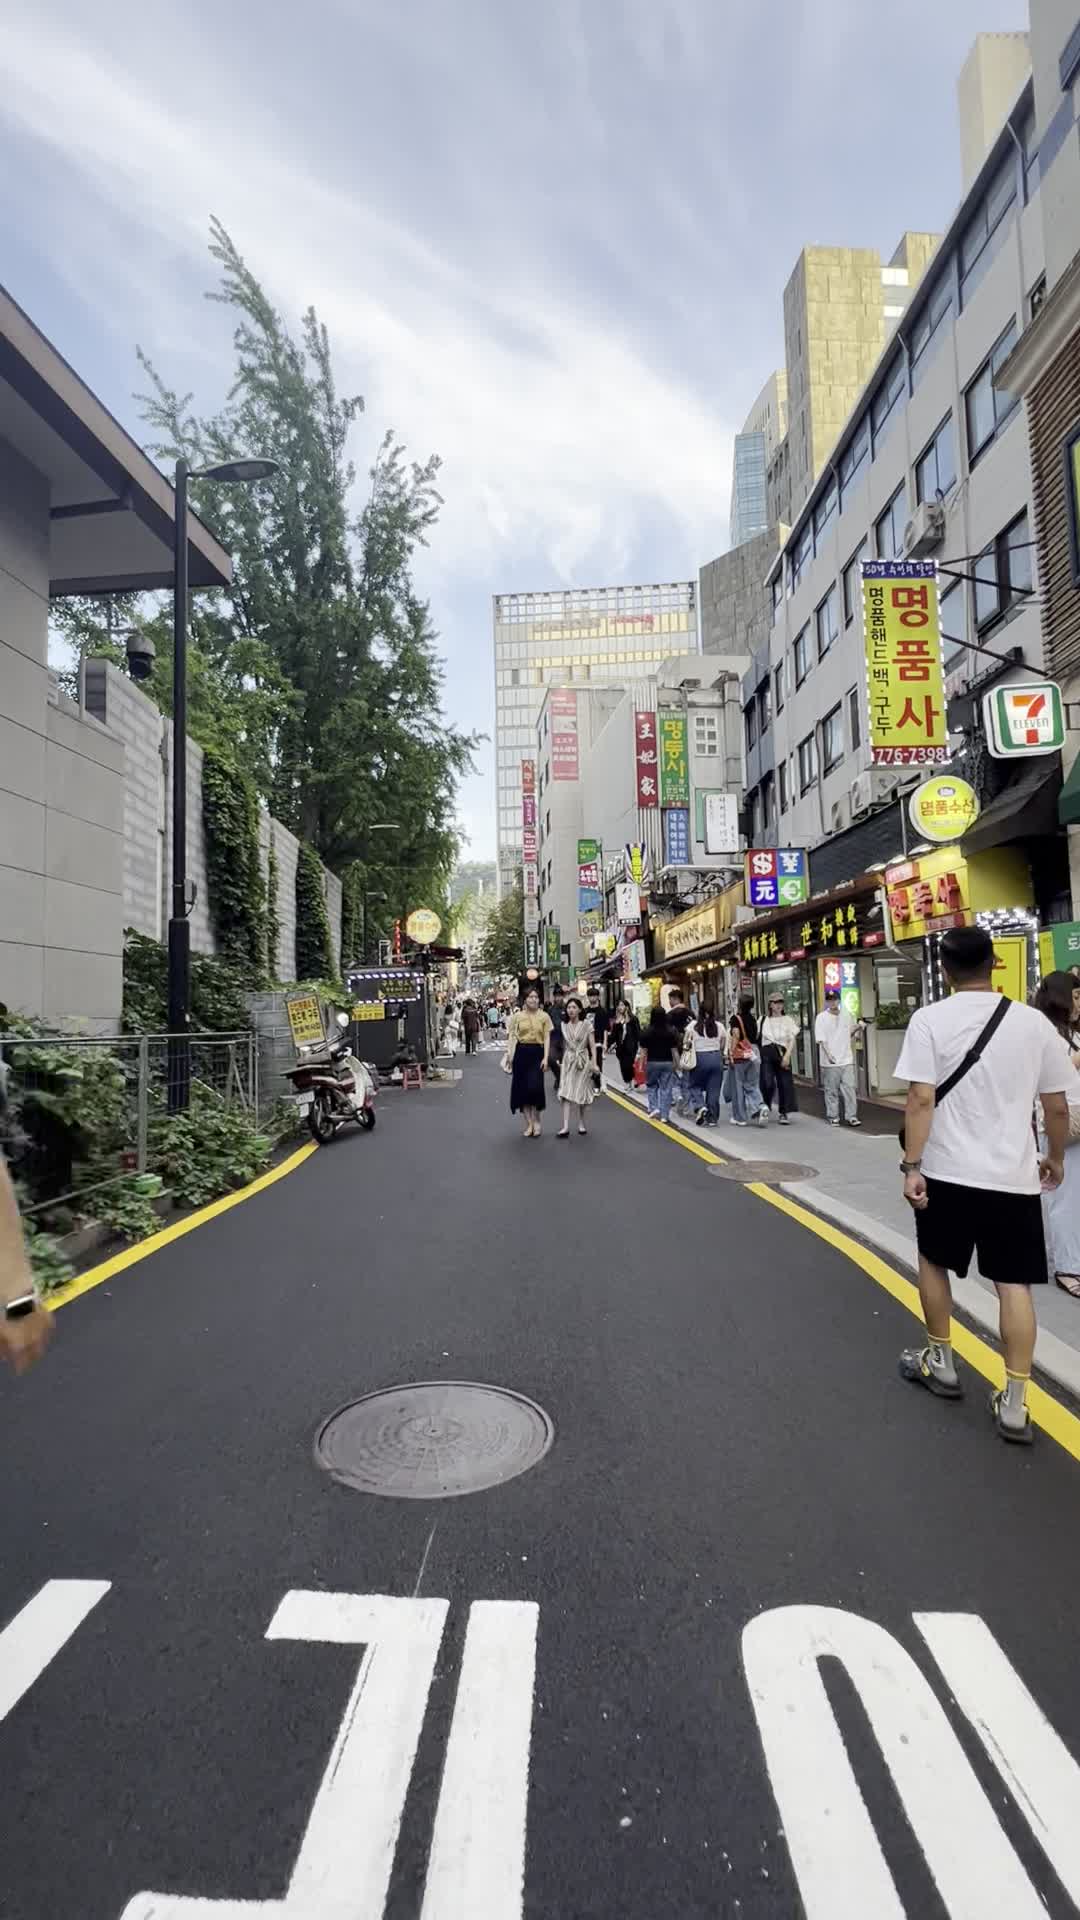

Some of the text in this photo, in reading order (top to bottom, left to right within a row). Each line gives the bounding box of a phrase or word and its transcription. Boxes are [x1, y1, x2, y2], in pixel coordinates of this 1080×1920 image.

[891, 585, 940, 738] 명품사
[875, 746, 945, 761] 776-7398
[920, 799, 975, 817] 명품수선
[752, 852, 800, 875] $ ¥
[756, 880, 801, 901] 元 €
[825, 961, 840, 986] $
